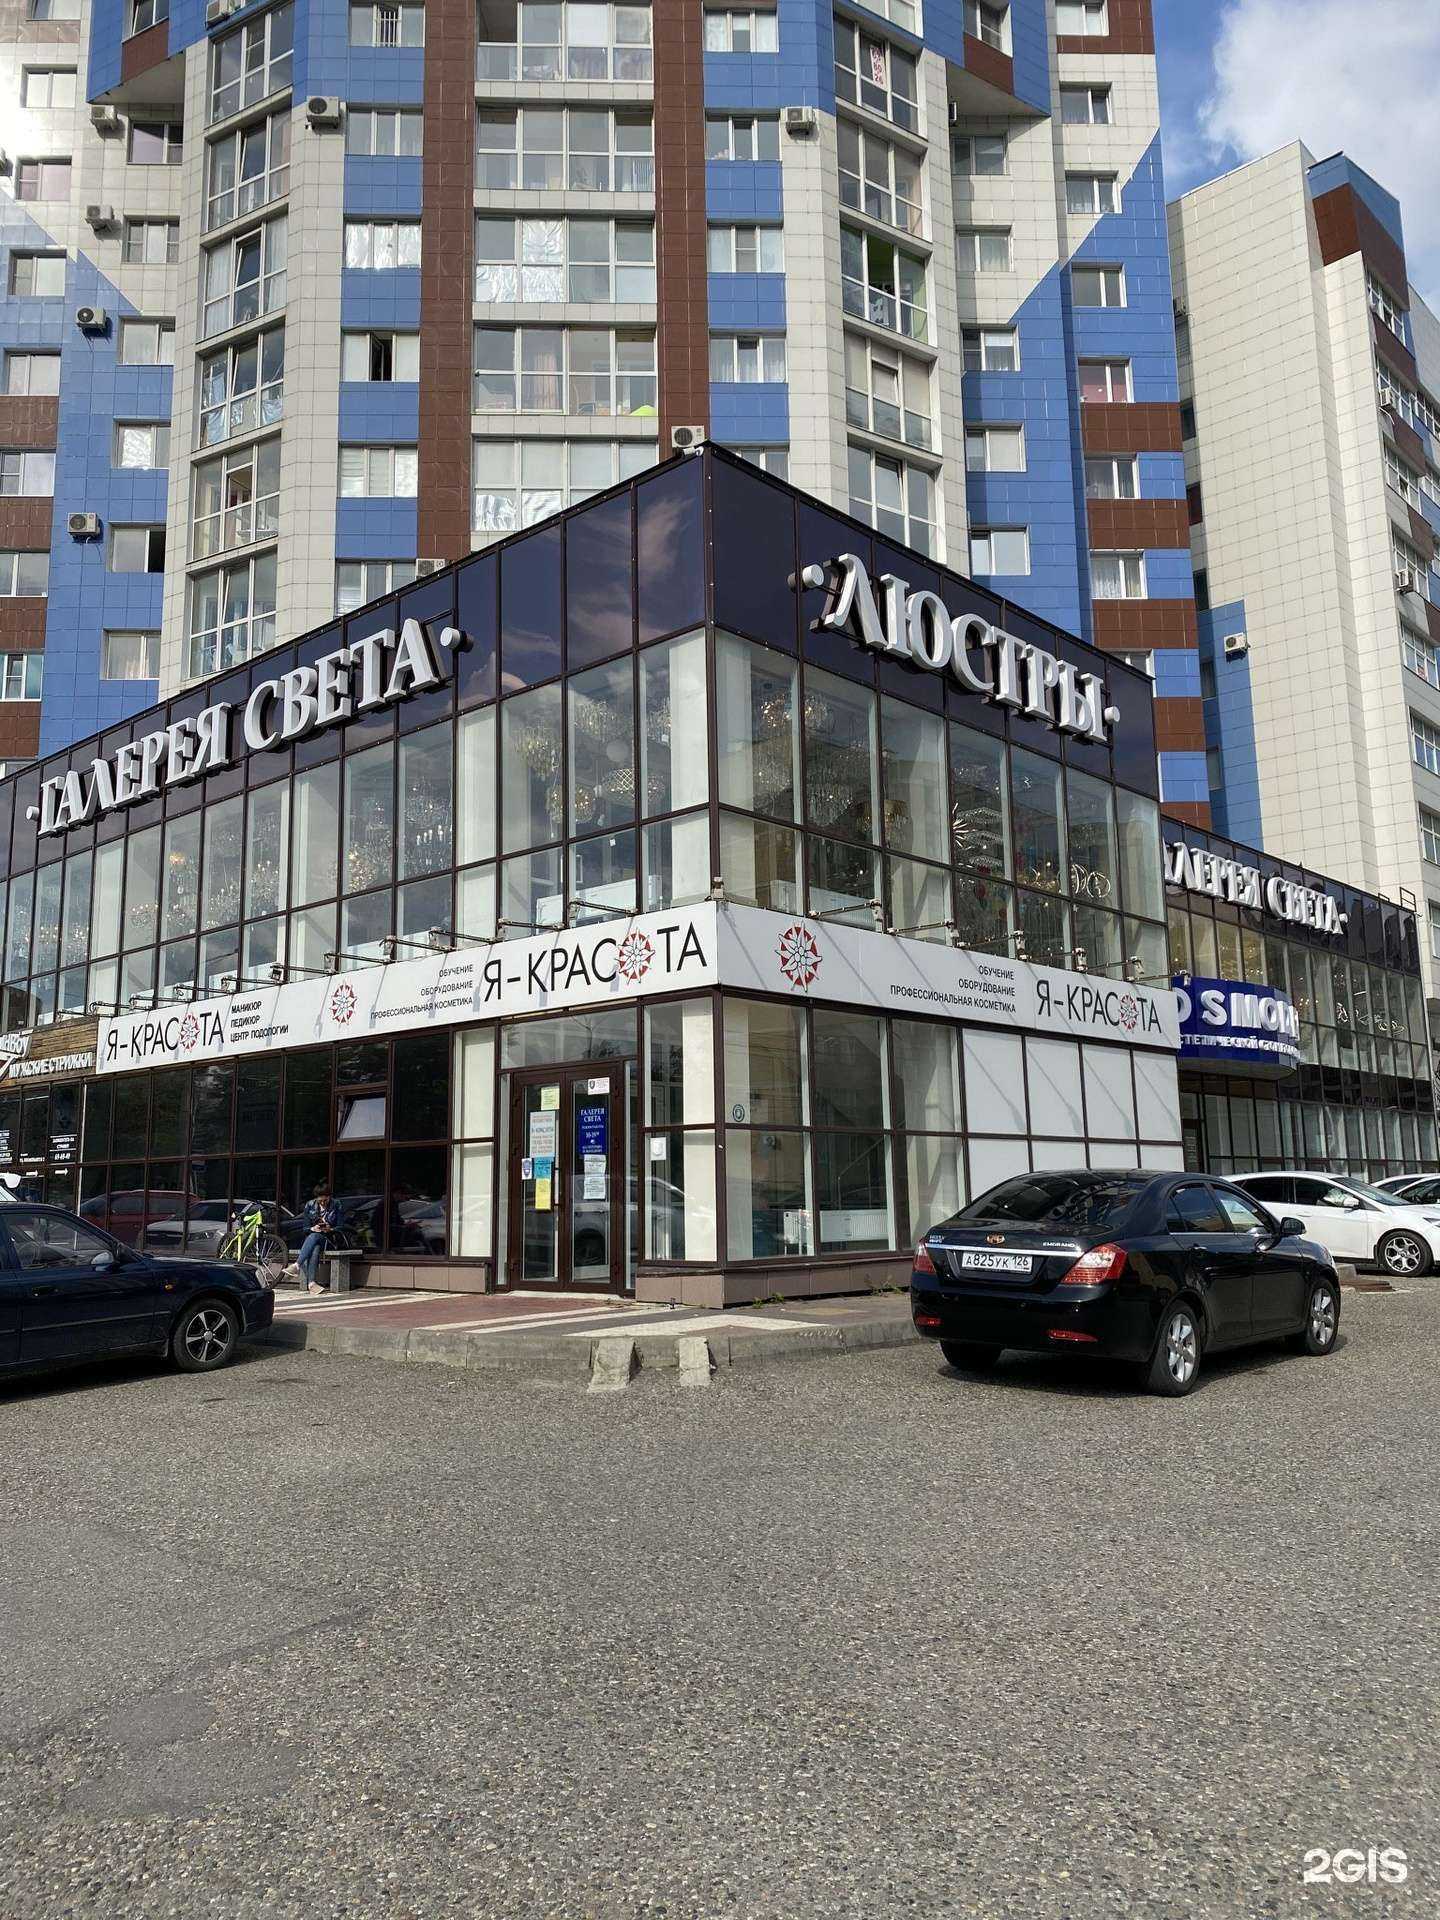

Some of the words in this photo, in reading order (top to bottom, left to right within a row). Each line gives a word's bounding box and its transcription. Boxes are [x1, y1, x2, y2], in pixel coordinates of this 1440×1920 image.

[825, 553, 1108, 743] ЛЮСТРЫ
[37, 701, 233, 836] ГАЛЕРЕЯ
[244, 617, 441, 752] СВЕТА
[1267, 875, 1344, 935] СВЕТА
[438, 963, 474, 978] ОБУЧЕНИЕ
[978, 964, 1015, 981] ОБУЧЕНИЕ
[420, 980, 474, 997] ОБОРУДОВАНИЕ
[958, 978, 1016, 998] ОБОРУДОВАНИЕ
[231, 1000, 262, 1014] МАНИКЮР
[370, 1001, 433, 1020] ПРОФЕССИОНАЛЬНАЯ
[434, 996, 474, 1011] КОСМЕТИКА
[890, 984, 973, 1008] ПРОФЕССИОНАЛЬНАЯ
[974, 998, 1017, 1014] КОСМЕТИКА
[230, 1015, 261, 1028] ПЕДИКЮР
[230, 1031, 250, 1043] ЦЕНТР
[250, 1024, 289, 1040] ПОДОЛОГИИ
[9, 1058, 49, 1078] МУЖСКИЕ
[50, 1052, 93, 1073] СТРИЖКИ
[1011, 1255, 1029, 1267] 126
